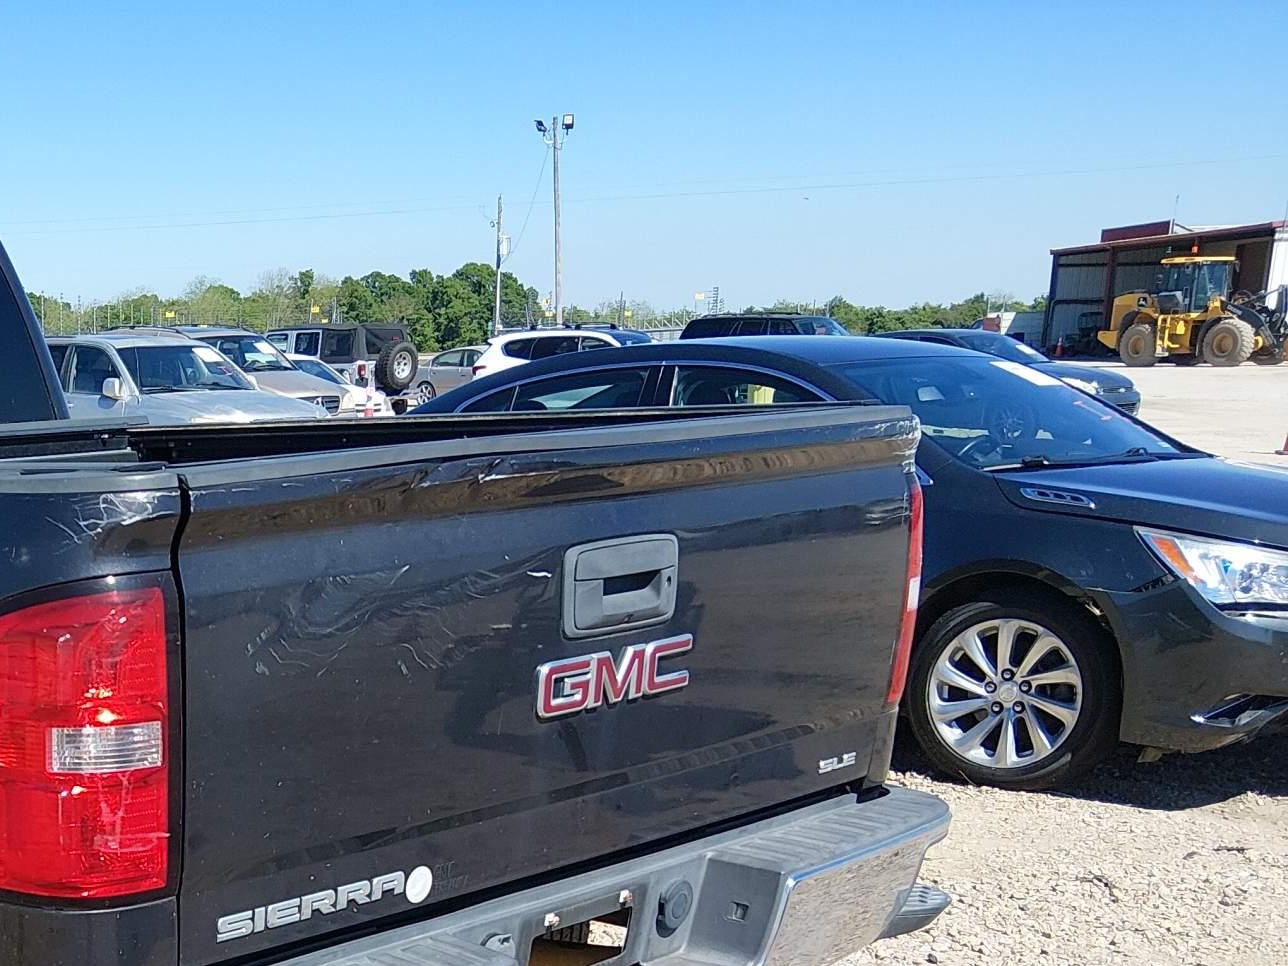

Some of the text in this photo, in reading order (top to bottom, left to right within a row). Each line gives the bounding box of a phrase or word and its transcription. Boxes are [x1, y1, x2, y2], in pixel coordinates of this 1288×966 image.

[536, 633, 694, 718] GMC
[818, 751, 857, 774] SLE
[216, 871, 405, 943] SIERRA
